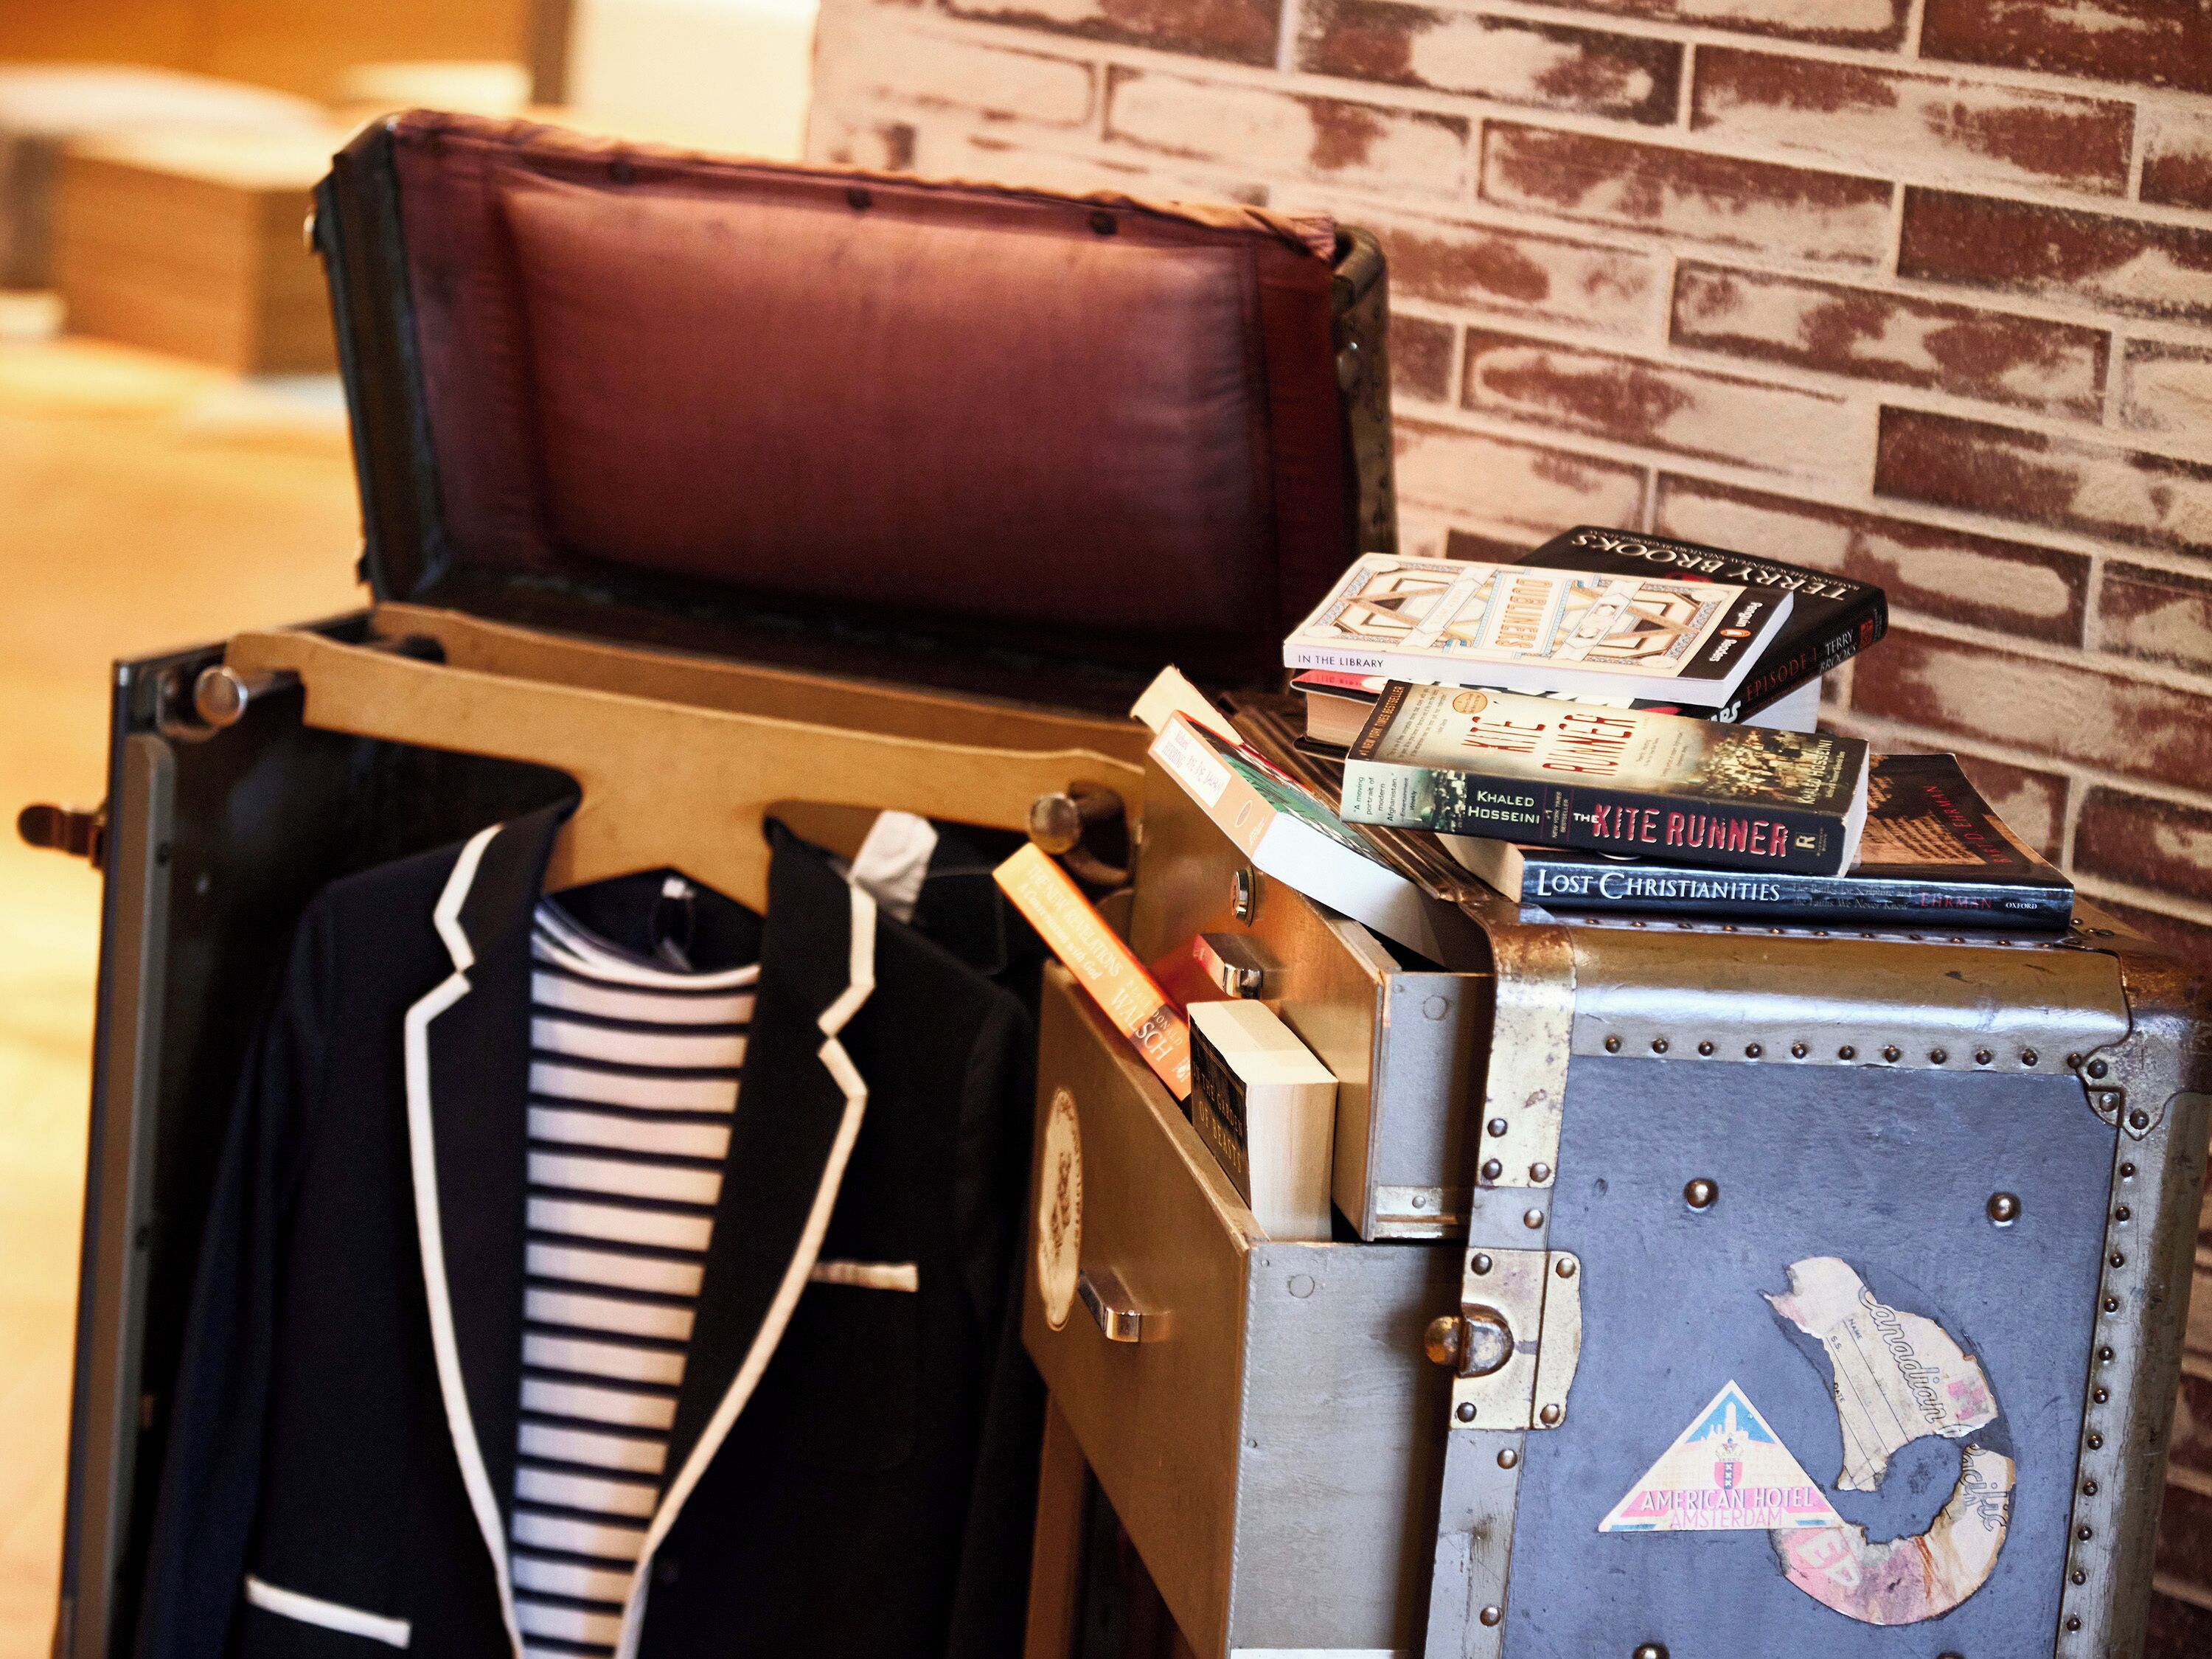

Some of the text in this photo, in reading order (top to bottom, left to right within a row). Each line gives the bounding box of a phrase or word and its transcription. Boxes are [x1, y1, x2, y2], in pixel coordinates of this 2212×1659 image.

[1572, 533, 1724, 573] BROOKS
[1725, 567, 1848, 600] TERRY
[1495, 578, 1553, 649] DUBLINERS
[1709, 602, 1763, 662] Penguin Readers
[1298, 655, 1384, 668] IN THE LIBRARY
[1819, 628, 1858, 675] TERRY BROOKS
[1746, 654, 1811, 702] EPISODE
[1384, 686, 1405, 713] BESTSELLER
[1370, 727, 1383, 737] YORK
[1374, 714, 1390, 726] TIMES
[1461, 716, 1546, 753] KITE
[1363, 739, 1376, 749] NEW
[1542, 714, 1638, 776] RUNNER
[1799, 777, 1823, 804] KHALED
[1811, 739, 1834, 776] HOSSEINI
[1357, 776, 1365, 803] moving
[1366, 777, 1375, 815] portrait of
[1409, 790, 1417, 811] Weekly
[1478, 790, 1534, 807] KHALED
[1467, 806, 1540, 824] HOSSEINI
[1559, 799, 1569, 832] BESTSELLER
[1923, 785, 1972, 828] EHRMAN
[1573, 813, 1599, 824] THE
[1593, 803, 1660, 844] KITE
[1666, 811, 1788, 858] RUNNER
[1537, 869, 1781, 901] LOST CHRISTIANITIES
[1812, 885, 1837, 894] Battles
[1854, 885, 1894, 897] Scripture
[1919, 892, 1991, 909] EHRMAN
[1793, 898, 1805, 906] the
[1811, 899, 1833, 907] Faiths
[1837, 900, 1851, 908] We
[1854, 899, 1881, 909] Never
[1021, 886, 1071, 945] Conversation
[1064, 938, 1088, 963] with
[1081, 959, 1103, 982] God
[1025, 863, 1123, 978] THE NEW REVELATIONS
[1110, 987, 1174, 1062] WALSCH
[1150, 1007, 1184, 1048] DONALD
[1201, 1073, 1215, 1102] THE
[1217, 1093, 1243, 1138] GARDEN
[1199, 1100, 1242, 1174] OF BEASTS
[1831, 1335, 1842, 1352] S.S.
[1848, 1318, 1863, 1340] NAME
[1858, 1285, 1947, 1424] Canadian
[1834, 1381, 1846, 1403] DATE
[1641, 1486, 1814, 1512] AMERICAN HOTEL
[1670, 1509, 1783, 1529] AMSTERDAM
